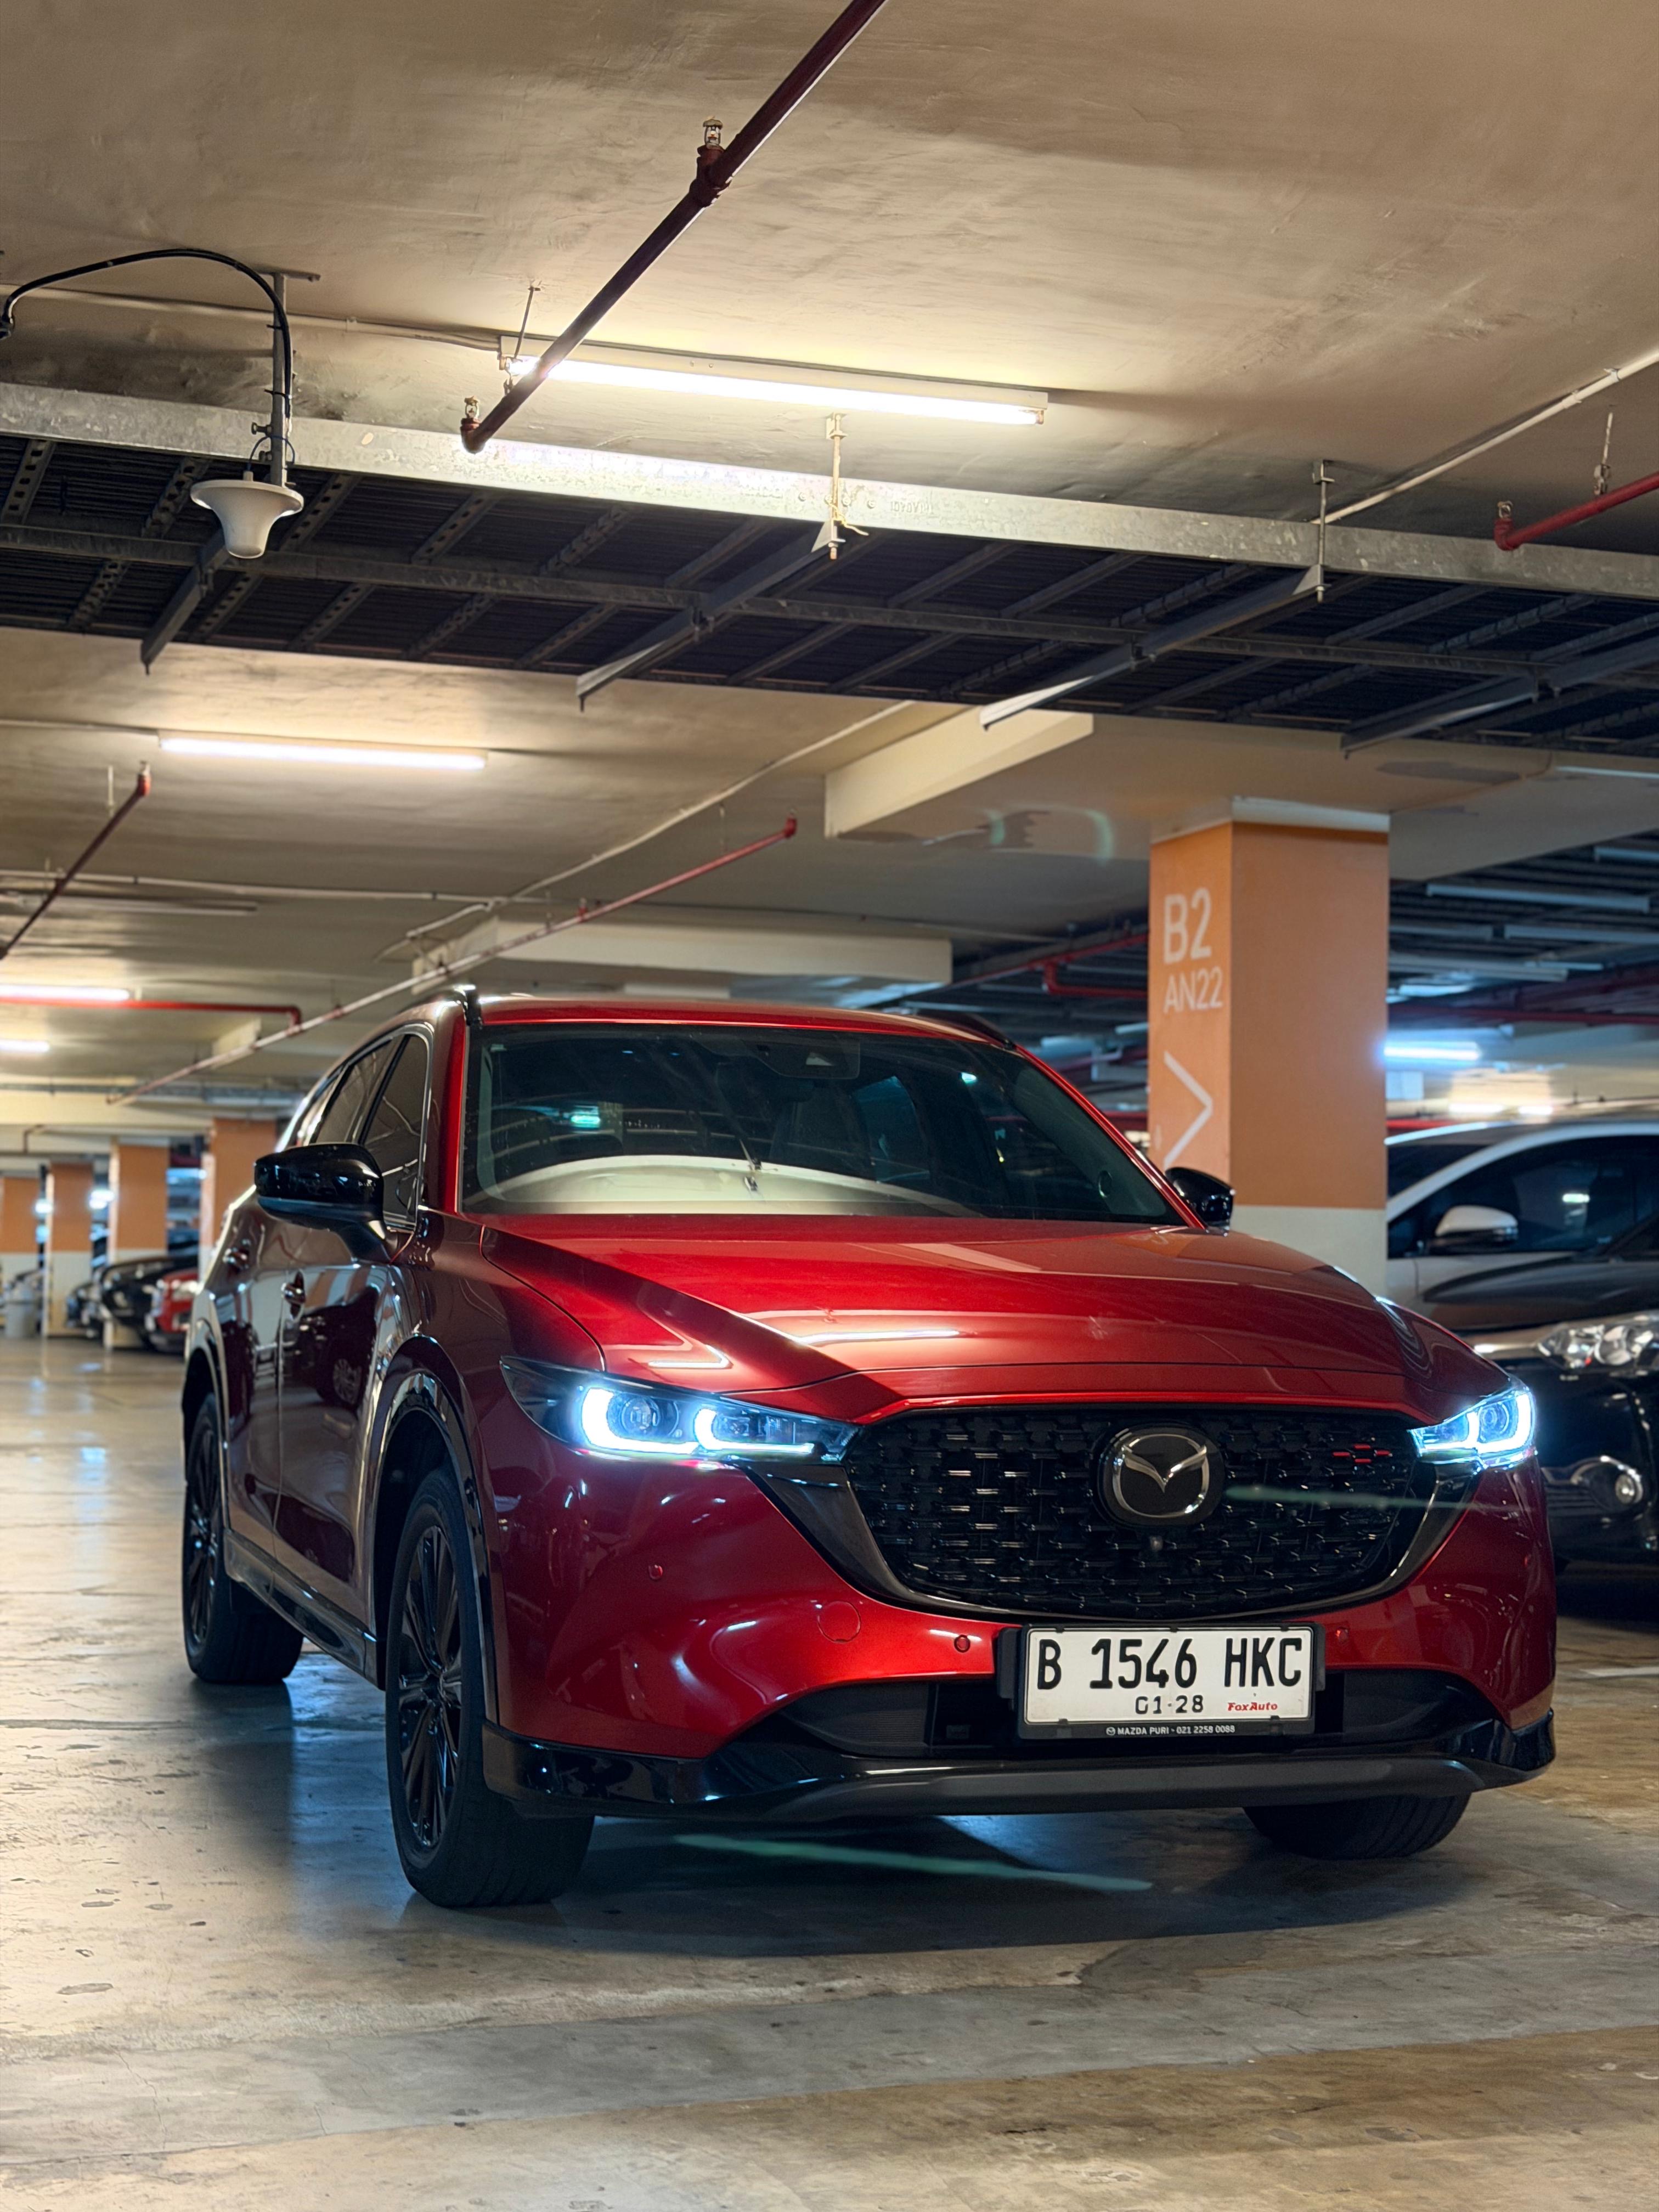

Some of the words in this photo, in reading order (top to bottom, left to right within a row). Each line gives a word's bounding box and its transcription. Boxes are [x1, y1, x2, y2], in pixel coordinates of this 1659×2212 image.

[1164, 888, 1212, 964] B2
[1164, 967, 1223, 1013] AN22
[1037, 1639, 1062, 1690] B
[1090, 1638, 1197, 1689] 1546
[1224, 1638, 1302, 1687] HKC
[1227, 1702, 1278, 1711] FoxAuto
[1117, 1727, 1147, 1735] MAZDA
[1149, 1726, 1169, 1735] PURI
[1176, 1726, 1192, 1734] 021
